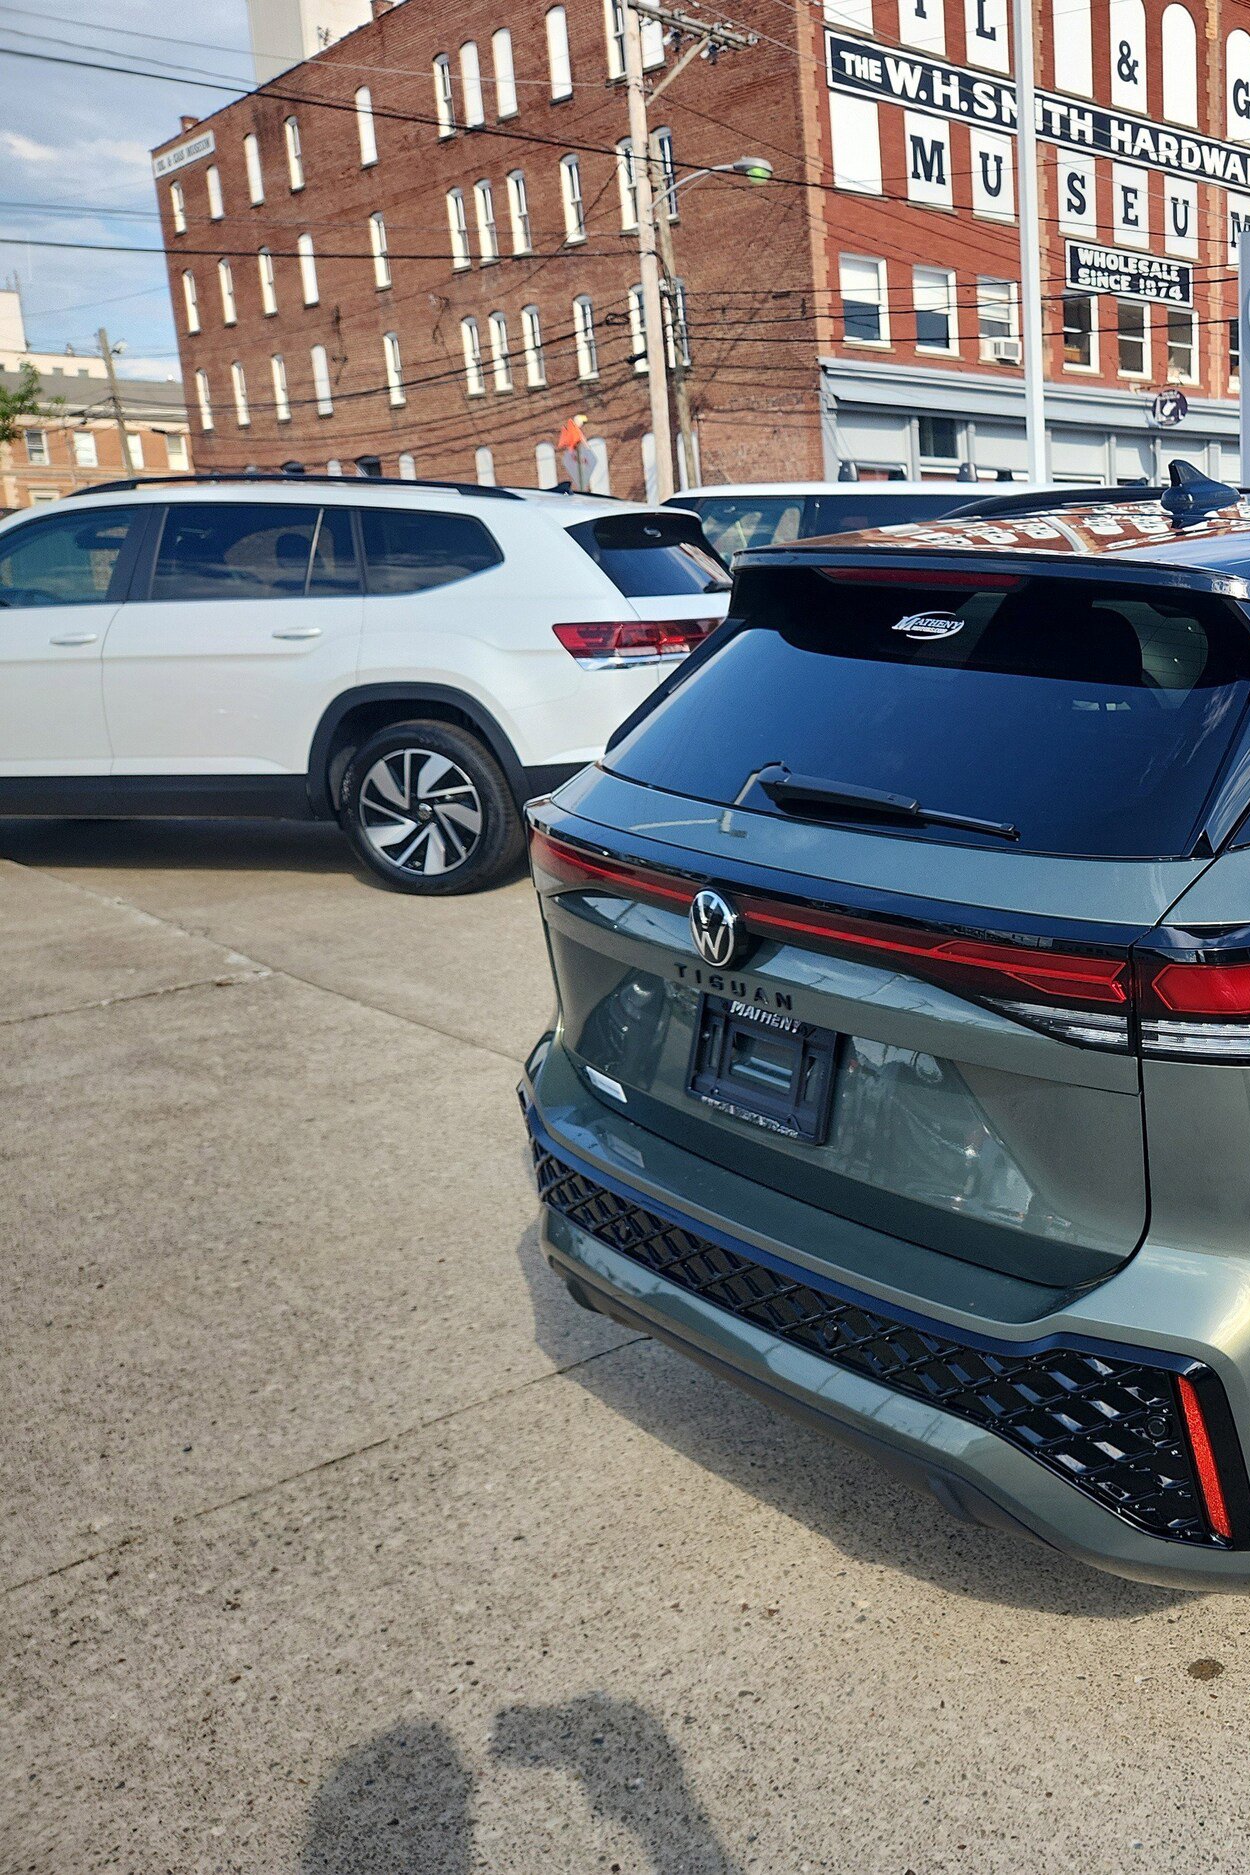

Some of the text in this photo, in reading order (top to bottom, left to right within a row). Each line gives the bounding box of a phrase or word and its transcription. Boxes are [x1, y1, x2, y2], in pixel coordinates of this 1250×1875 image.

[839, 51, 882, 83] THE
[1117, 40, 1139, 85] &
[1078, 248, 1180, 282] WHOLESALE
[1078, 268, 1183, 301] SINCE 1874
[892, 616, 962, 631] MATHENY
[674, 962, 792, 1011] TIGUAN
